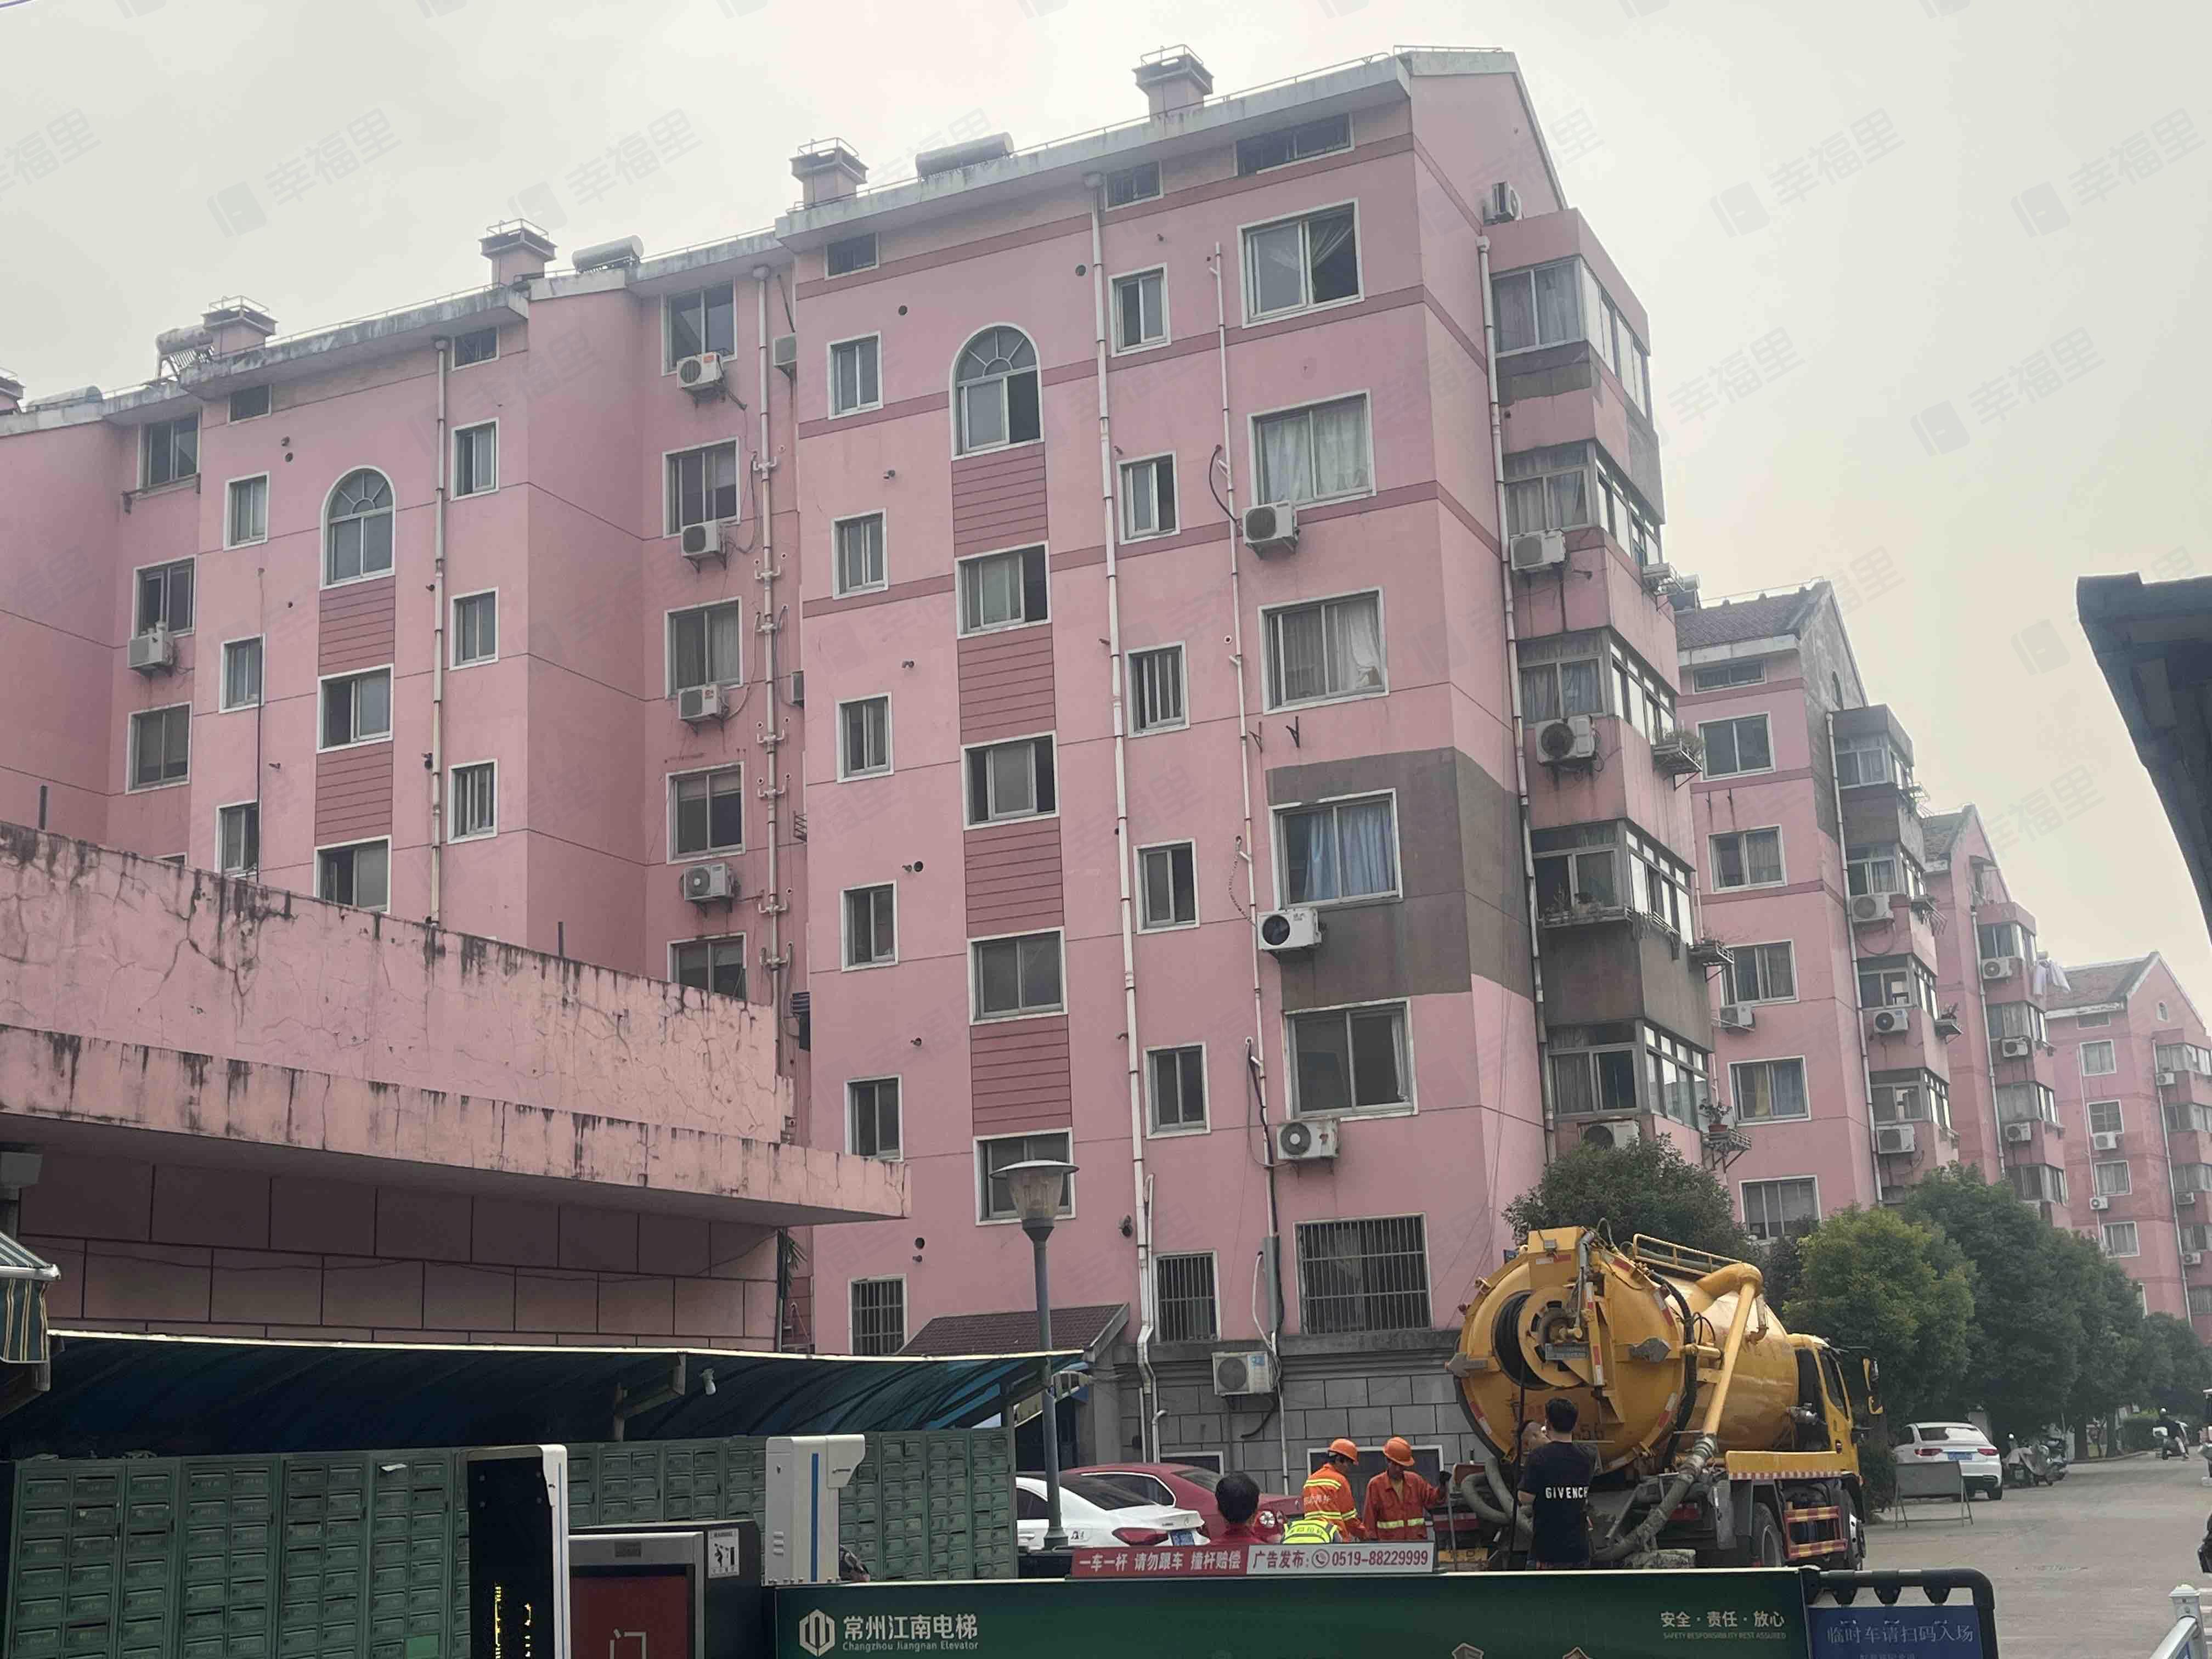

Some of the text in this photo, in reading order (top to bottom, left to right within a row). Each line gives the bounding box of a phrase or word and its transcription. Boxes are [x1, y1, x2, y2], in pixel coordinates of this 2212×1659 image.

[1079, 1551, 1242, 1571] 一车一杆 请勿跟车 撞杆赔偿
[1332, 1550, 1428, 1566] 0519-88229999
[843, 1613, 978, 1640] 常州江南电梯
[1826, 1625, 1974, 1643] 临时车请扫码入场
[842, 1640, 978, 1652] Changzhou Jiangnan Elevator
